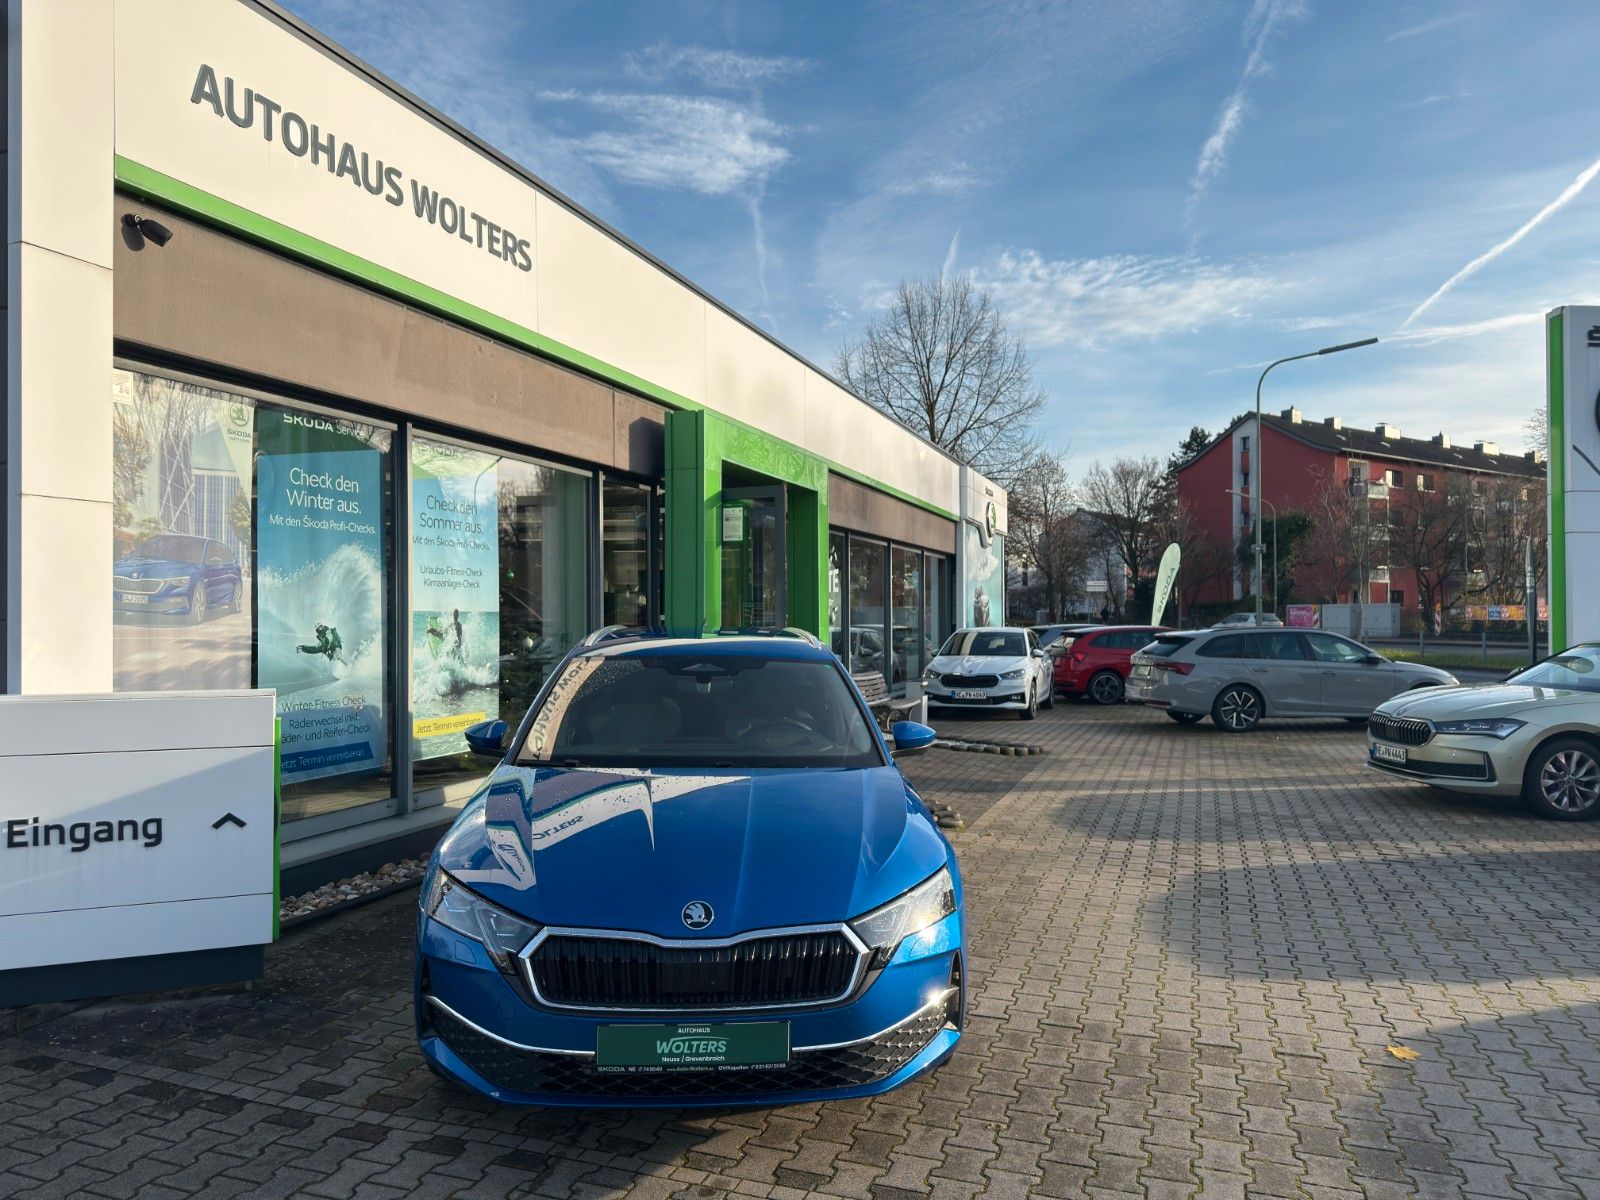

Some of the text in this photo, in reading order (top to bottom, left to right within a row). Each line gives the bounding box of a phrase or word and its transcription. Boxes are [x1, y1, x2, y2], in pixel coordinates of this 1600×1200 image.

[190, 64, 533, 273] AUTOHAUS WOLTERS
[337, 424, 365, 439] Service
[289, 467, 359, 493] Check den
[286, 488, 362, 515] Winter aus.
[426, 495, 478, 516] Check den
[269, 514, 377, 535] Mit den Škoda Profi-Checks.
[420, 512, 484, 535] Sommer aus.
[424, 537, 436, 546] den
[436, 535, 456, 548] Škoda
[281, 695, 368, 713] Winter-Fitness-Check
[281, 723, 372, 744] äder- und Reifen-Check
[416, 724, 432, 734] Jetzt
[433, 721, 453, 731] Termin
[281, 759, 297, 769] etzt
[298, 754, 325, 767] Termin
[6, 816, 163, 852] Eingang
[656, 1038, 728, 1054] WOLTERS
[685, 1054, 725, 1062] Grevenbroich
